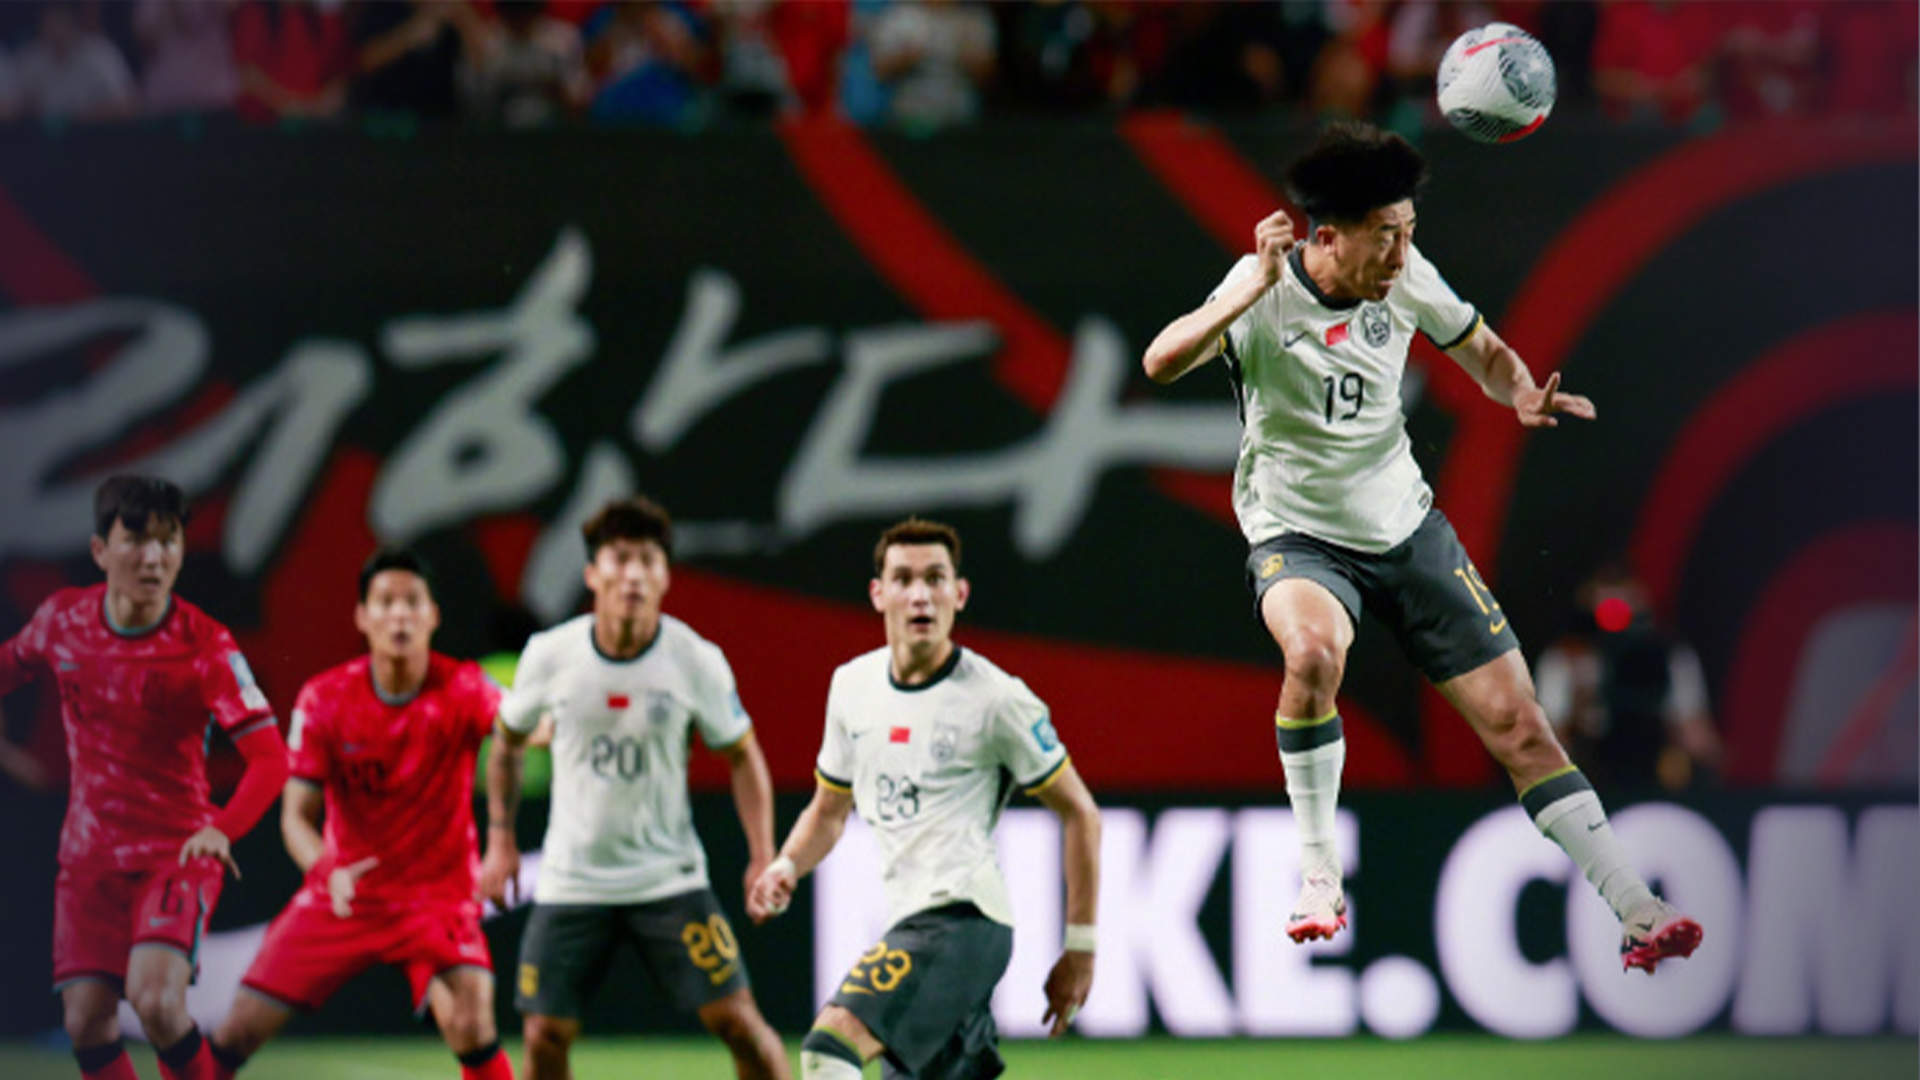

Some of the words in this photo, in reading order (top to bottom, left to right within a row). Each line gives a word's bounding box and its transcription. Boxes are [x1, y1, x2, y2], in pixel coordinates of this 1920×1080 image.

[1323, 372, 1364, 424] 19
[592, 734, 642, 782] 20
[875, 774, 919, 821] 23
[682, 914, 738, 968] 20
